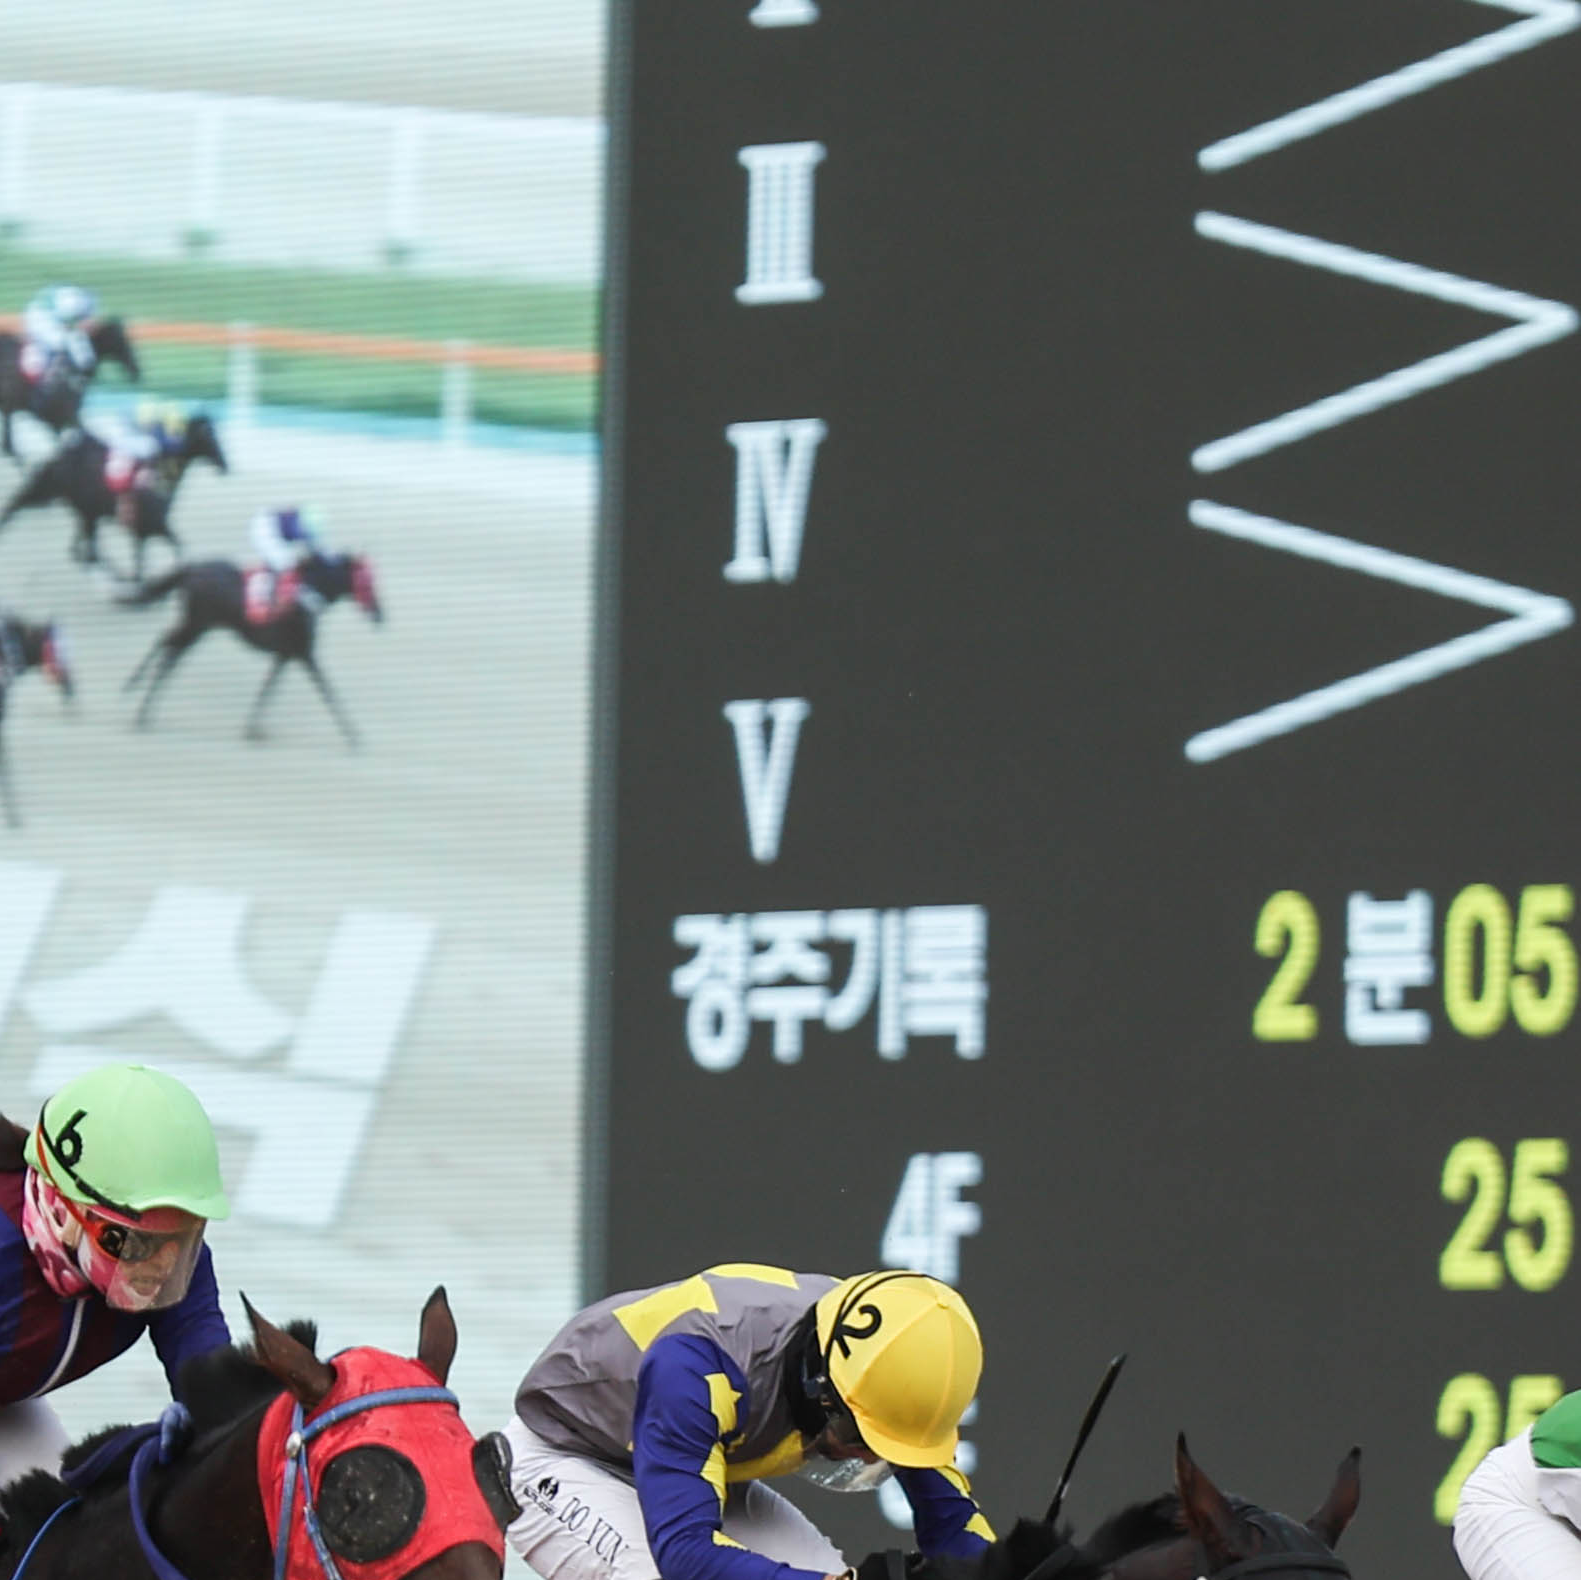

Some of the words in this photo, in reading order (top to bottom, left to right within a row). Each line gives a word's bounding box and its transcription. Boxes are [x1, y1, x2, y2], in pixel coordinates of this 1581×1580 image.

[723, 697, 811, 865] V
[672, 904, 988, 1073] 경주기록
[55, 1108, 88, 1168] 6
[1438, 1137, 1573, 1293] 25
[834, 1303, 883, 1361] 2
